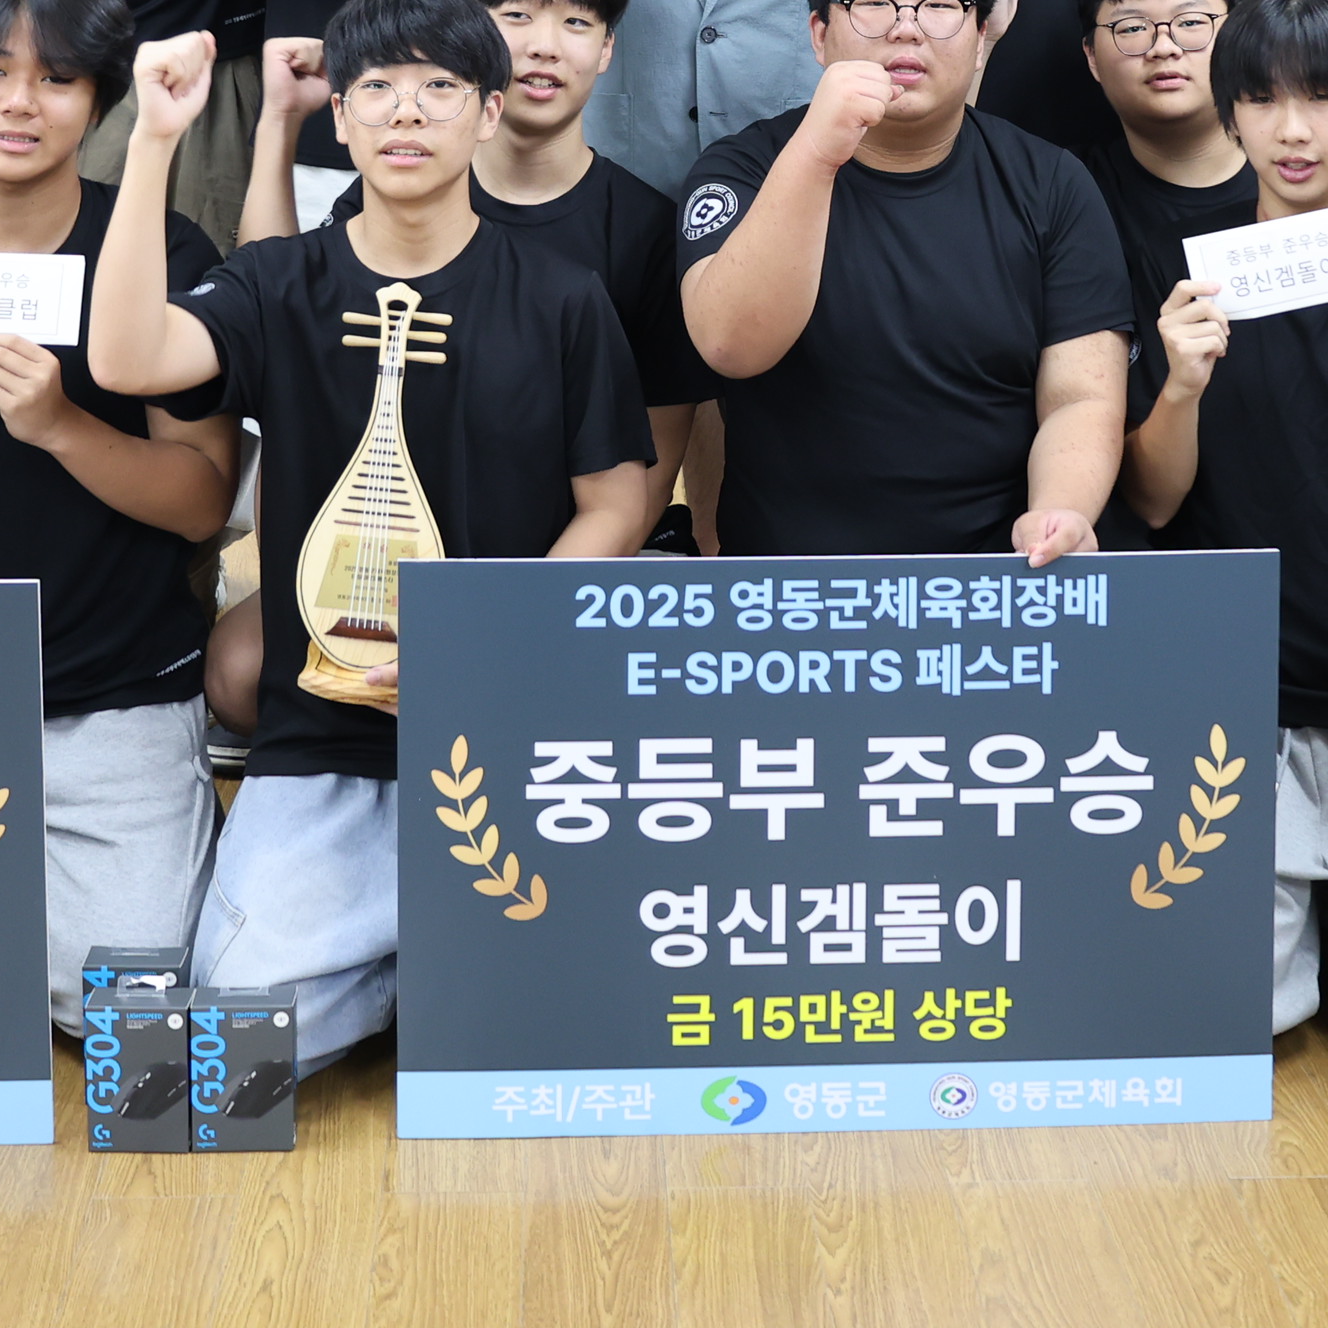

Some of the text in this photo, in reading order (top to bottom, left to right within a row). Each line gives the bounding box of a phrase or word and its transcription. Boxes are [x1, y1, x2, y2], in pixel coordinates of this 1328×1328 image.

[1227, 232, 1328, 266] 중등부 준우승
[0, 272, 30, 289] 우승
[576, 574, 1107, 631] 2025 영동군체육회장배
[628, 642, 1058, 695] E-SPORTS 페스타
[526, 731, 1153, 843] 중등부 준우승
[640, 880, 1021, 967] 영신겜돌이
[667, 987, 1012, 1045] 금 15만원 상당
[85, 1006, 121, 1114] G304
[190, 1006, 227, 1114] G304
[492, 1082, 656, 1122] 주최/주관
[784, 1082, 886, 1119] 영동군
[989, 1077, 1182, 1112] 영동군체육회
